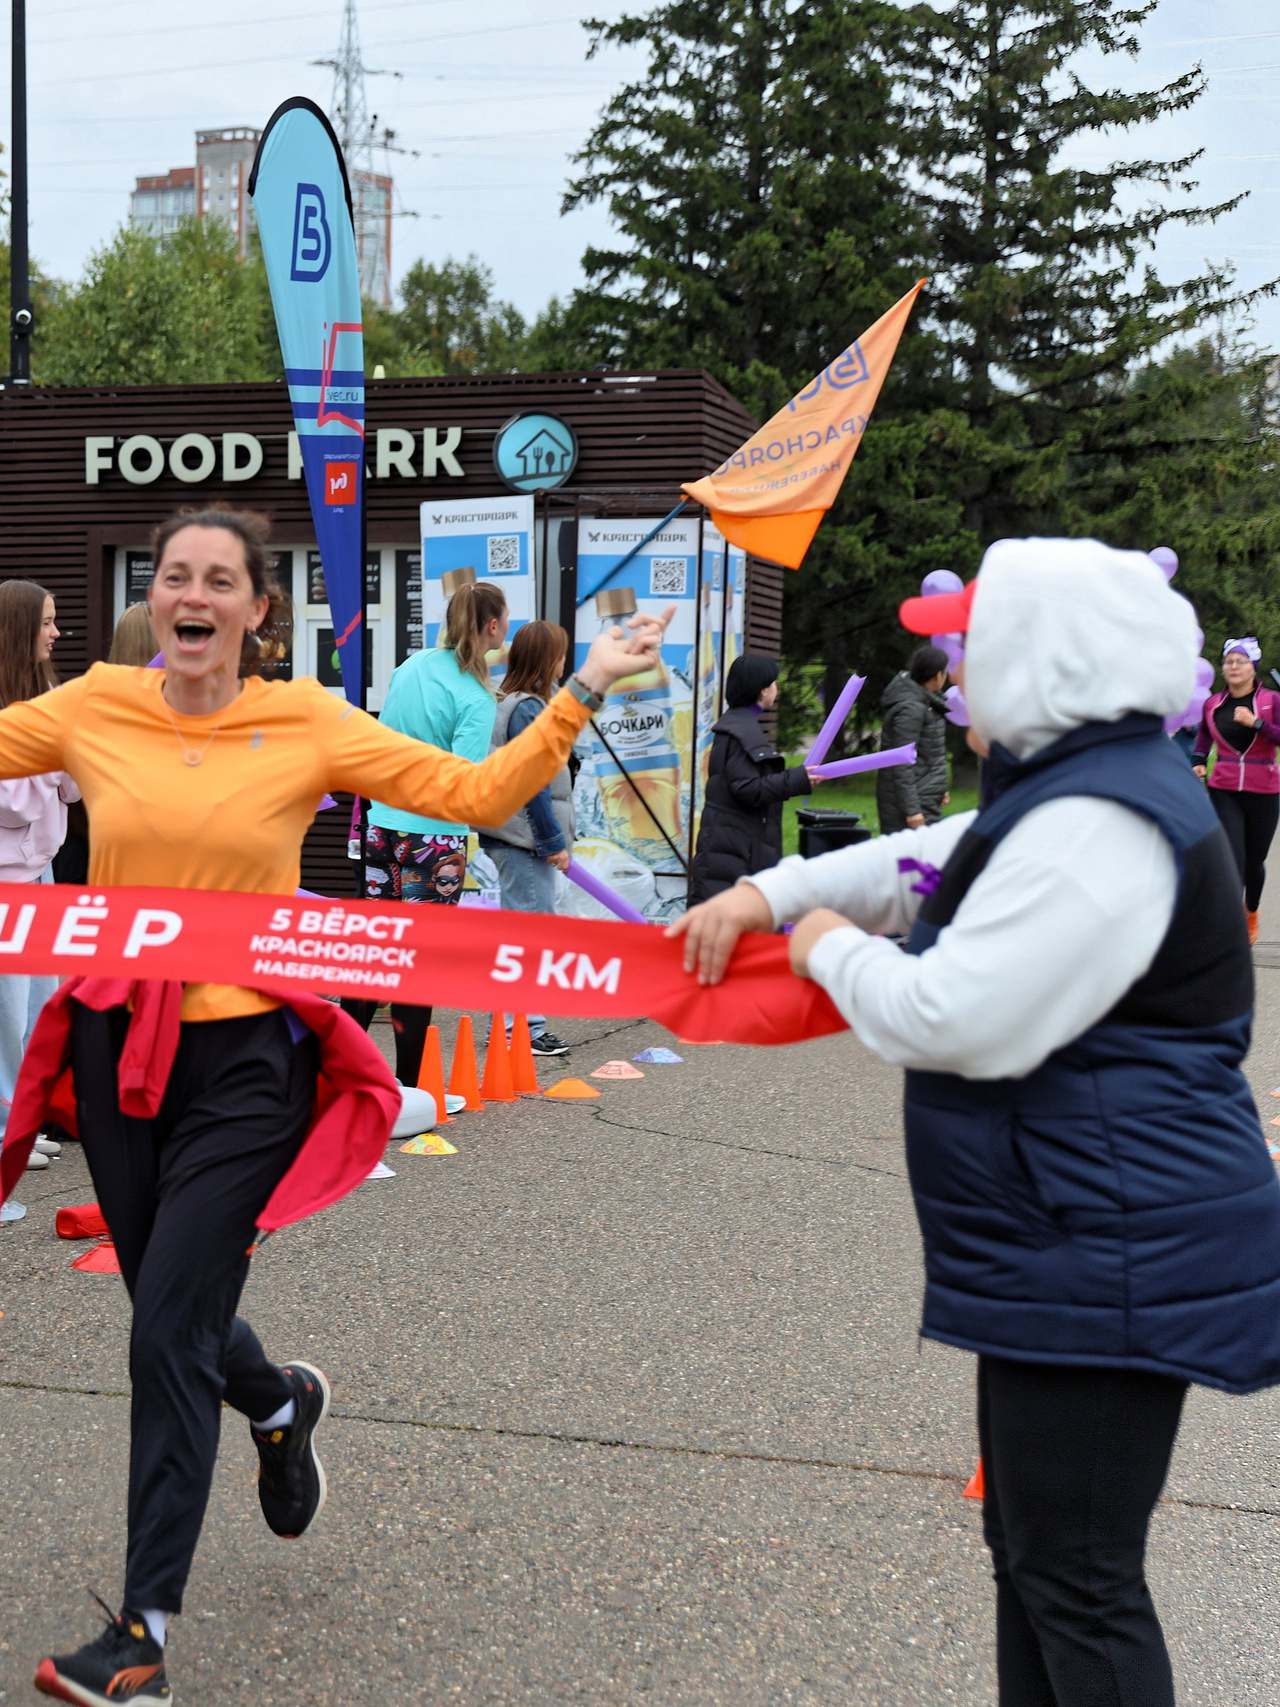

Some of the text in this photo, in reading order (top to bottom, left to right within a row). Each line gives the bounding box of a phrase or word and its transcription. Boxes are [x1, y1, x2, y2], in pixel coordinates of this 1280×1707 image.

[85, 427, 465, 485] FOOD RK
[600, 715, 665, 737] БОЧКАРИ
[269, 907, 413, 941] 5 ВЁРСТ
[249, 935, 417, 968] КРАСНОЯРСК
[253, 959, 401, 988] НАБЕРЕЖНАЯ
[491, 944, 623, 995] 5 КМ
